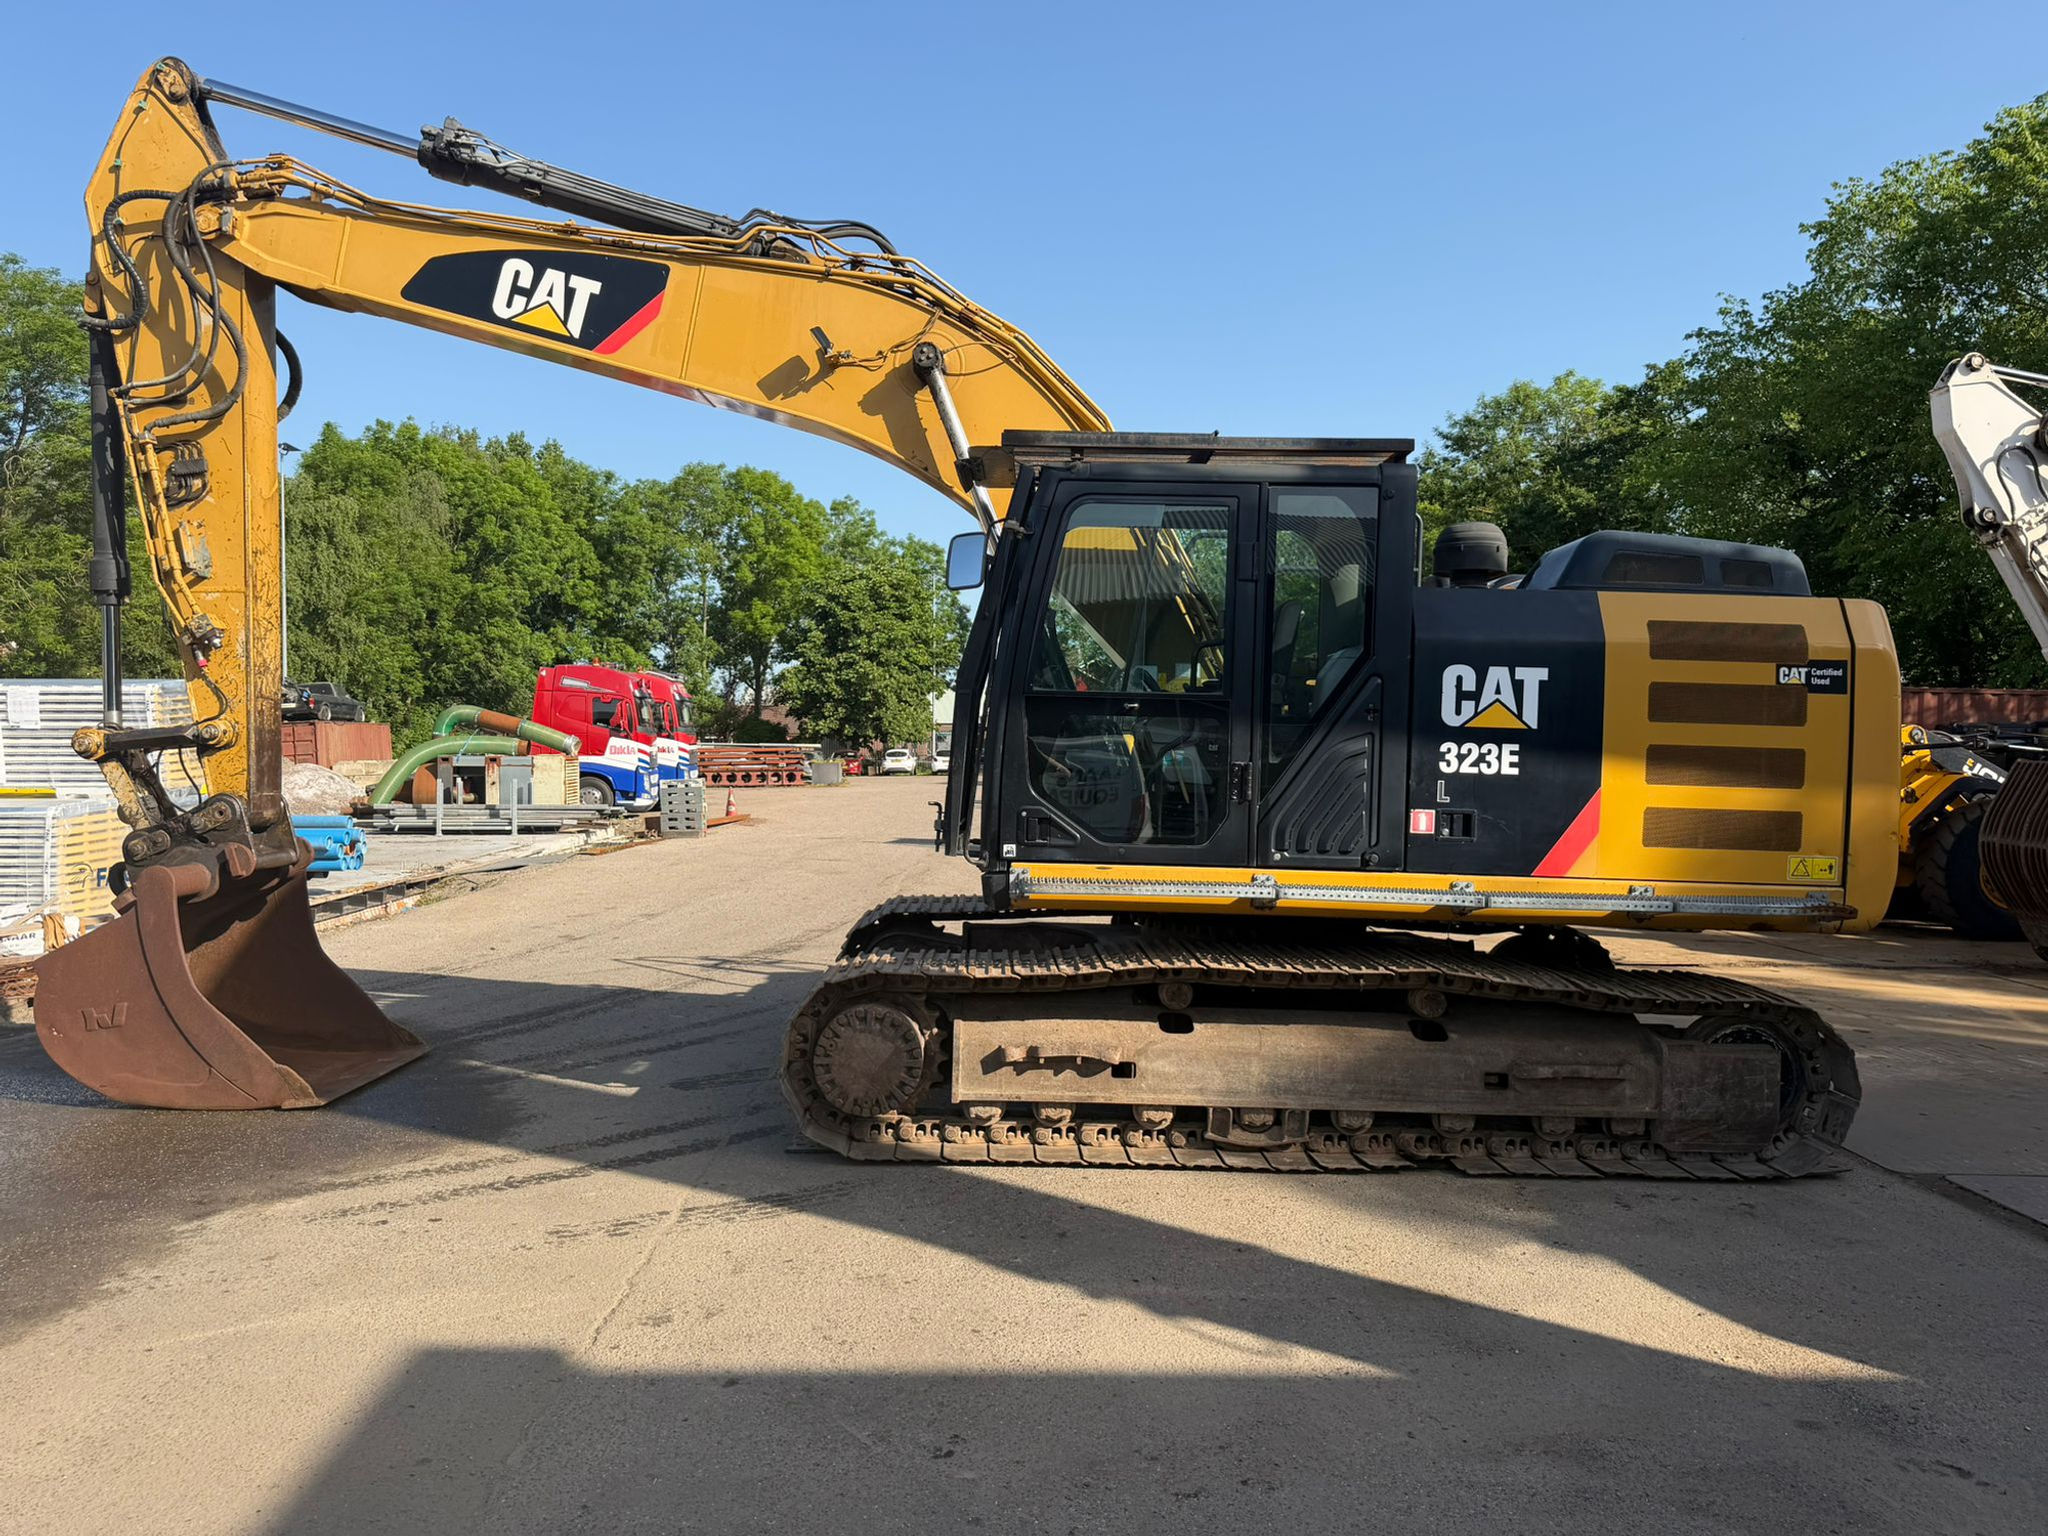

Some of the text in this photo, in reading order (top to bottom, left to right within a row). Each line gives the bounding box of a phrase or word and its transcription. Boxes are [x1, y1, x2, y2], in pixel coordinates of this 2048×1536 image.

[492, 257, 602, 340] CAT
[1778, 666, 1843, 685] CAT Certified
[1811, 677, 1831, 686] Used
[1441, 664, 1549, 730] CAT
[1438, 741, 1520, 776] 323E
[1436, 779, 1451, 803] L
[1416, 812, 1428, 832] 1
